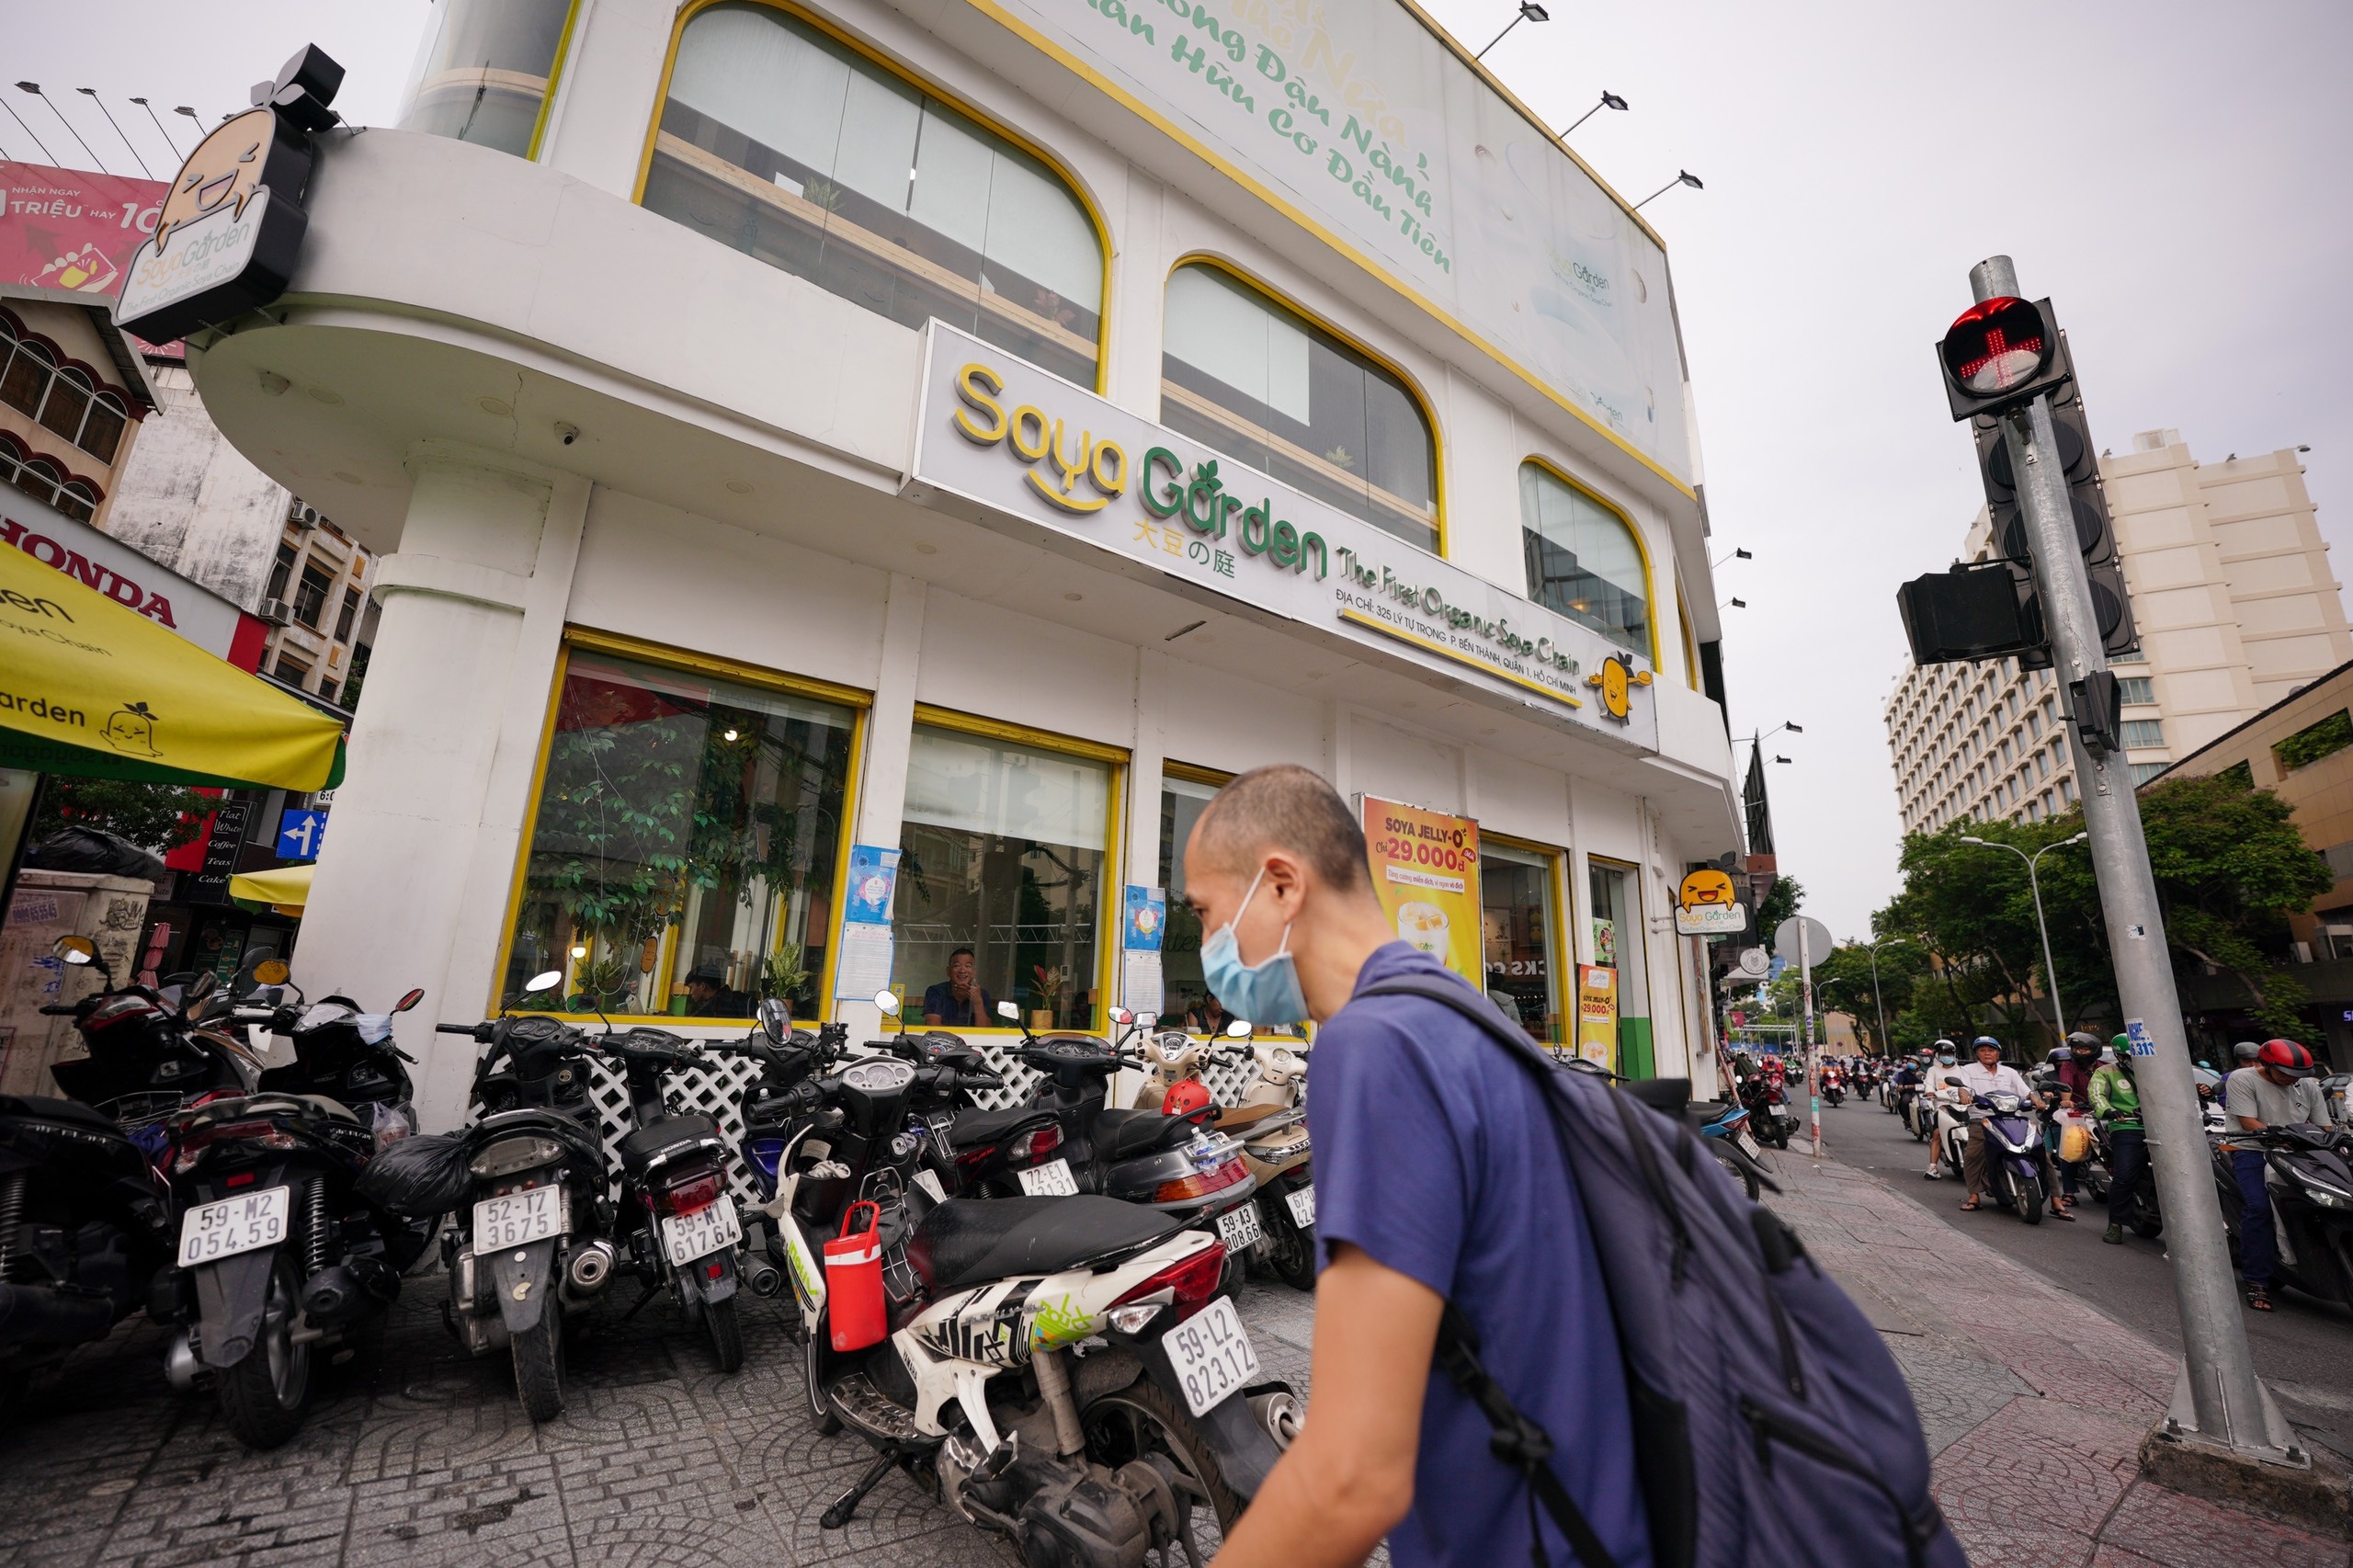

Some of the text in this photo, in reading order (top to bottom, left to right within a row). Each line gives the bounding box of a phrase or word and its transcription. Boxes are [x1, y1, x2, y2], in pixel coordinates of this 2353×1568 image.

[1254, 43, 1330, 127] Đậu
[1171, 34, 1254, 114] Hữu
[1326, 148, 1391, 222] Đầu
[1400, 209, 1449, 275] Tiên
[12, 186, 81, 197] NHẬN NGAY
[10, 199, 83, 219] TRIỆU
[90, 209, 117, 221] HAY
[951, 363, 1327, 582] Soya Garden
[1133, 517, 1235, 578] 大豆の庭
[1336, 546, 1580, 676] The First Organic Soya Chain
[1336, 588, 1353, 606] ĐỊA
[1377, 605, 1392, 620] 325
[1393, 611, 1404, 625] LÝ
[1404, 617, 1415, 631] TỰ
[1416, 621, 1446, 642] TRỌNG
[1459, 637, 1474, 653] BẾN
[1503, 656, 1525, 676] QUẬN
[1533, 670, 1545, 682] HỒ
[1547, 675, 1559, 687] CHÍ
[1559, 678, 1576, 695] MINH
[220, 808, 242, 820] Flat
[208, 839, 237, 850] Coffee
[1385, 816, 1463, 848] SOYA JELLY-O
[207, 857, 232, 866] Teas
[199, 874, 225, 884] Cake
[1705, 910, 1741, 921] Garden
[660, 1138, 693, 1154] HONDA
[1026, 1163, 1064, 1187] 72-E1
[200, 1195, 272, 1231] 59-M2
[487, 1191, 546, 1223] 52-T7
[674, 1202, 723, 1237] 59-N1
[1222, 1208, 1252, 1233] 59-A3
[188, 1217, 279, 1260] 054.59
[487, 1213, 549, 1247] 3675
[673, 1221, 737, 1261] 617.64
[1176, 1308, 1233, 1365] 59-L2
[1186, 1338, 1255, 1407] 823.12
